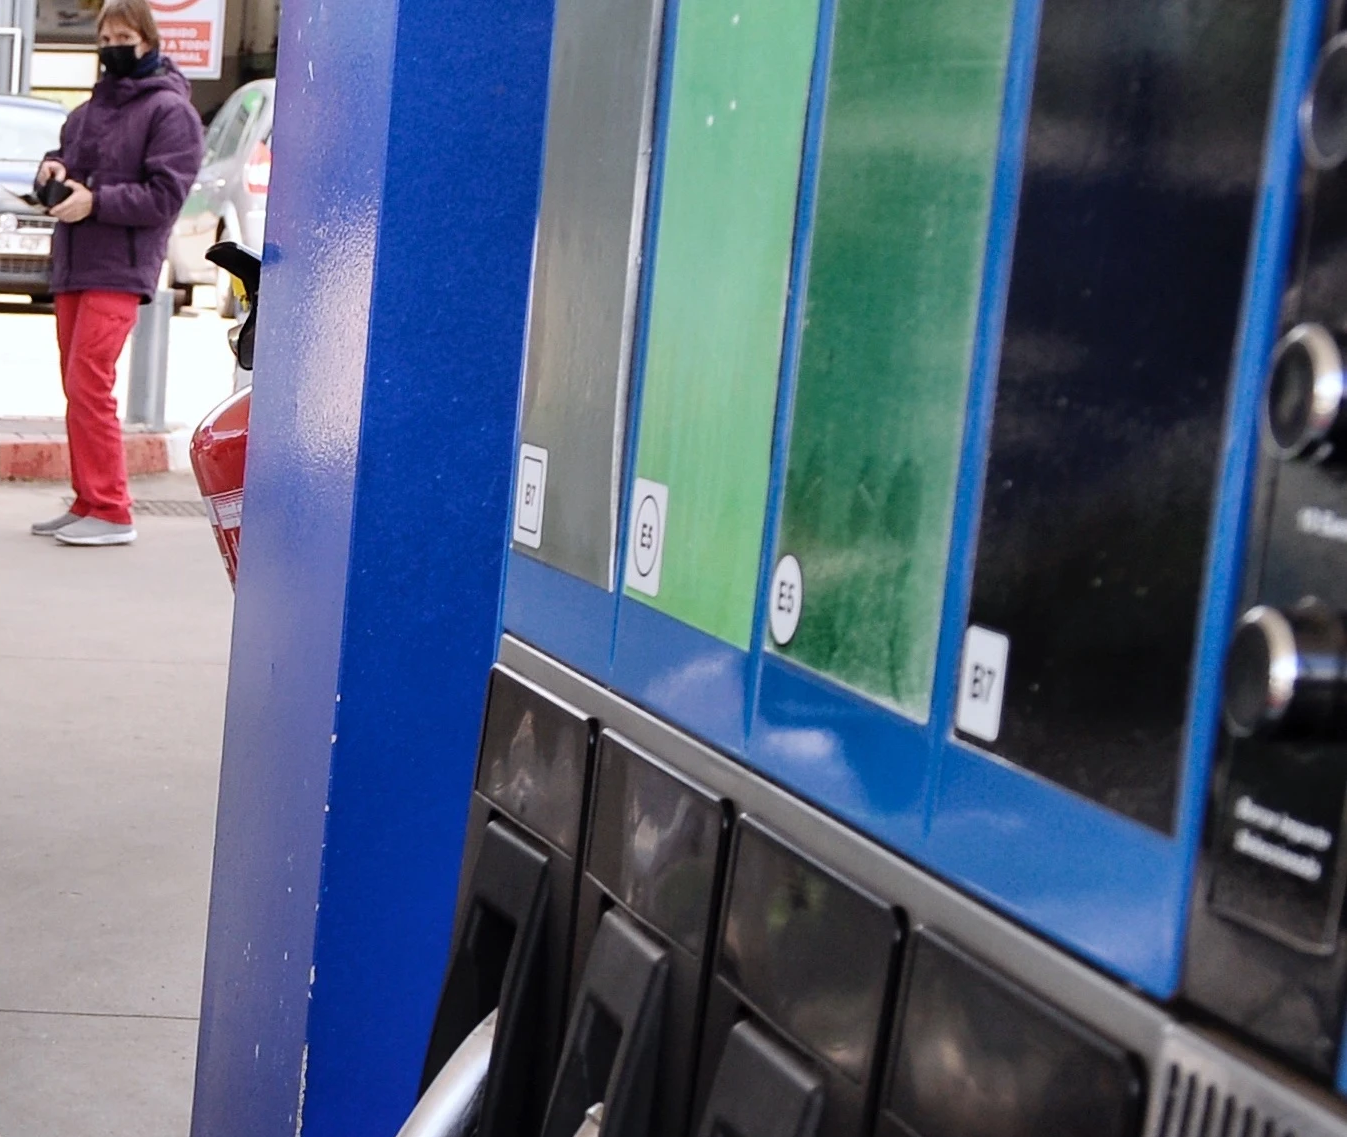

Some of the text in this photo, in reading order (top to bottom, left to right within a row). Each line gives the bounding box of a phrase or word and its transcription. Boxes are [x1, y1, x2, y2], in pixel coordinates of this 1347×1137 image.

[524, 482, 537, 507] B7
[640, 522, 653, 550] E5
[776, 580, 794, 614] E5
[970, 663, 996, 705] B7
